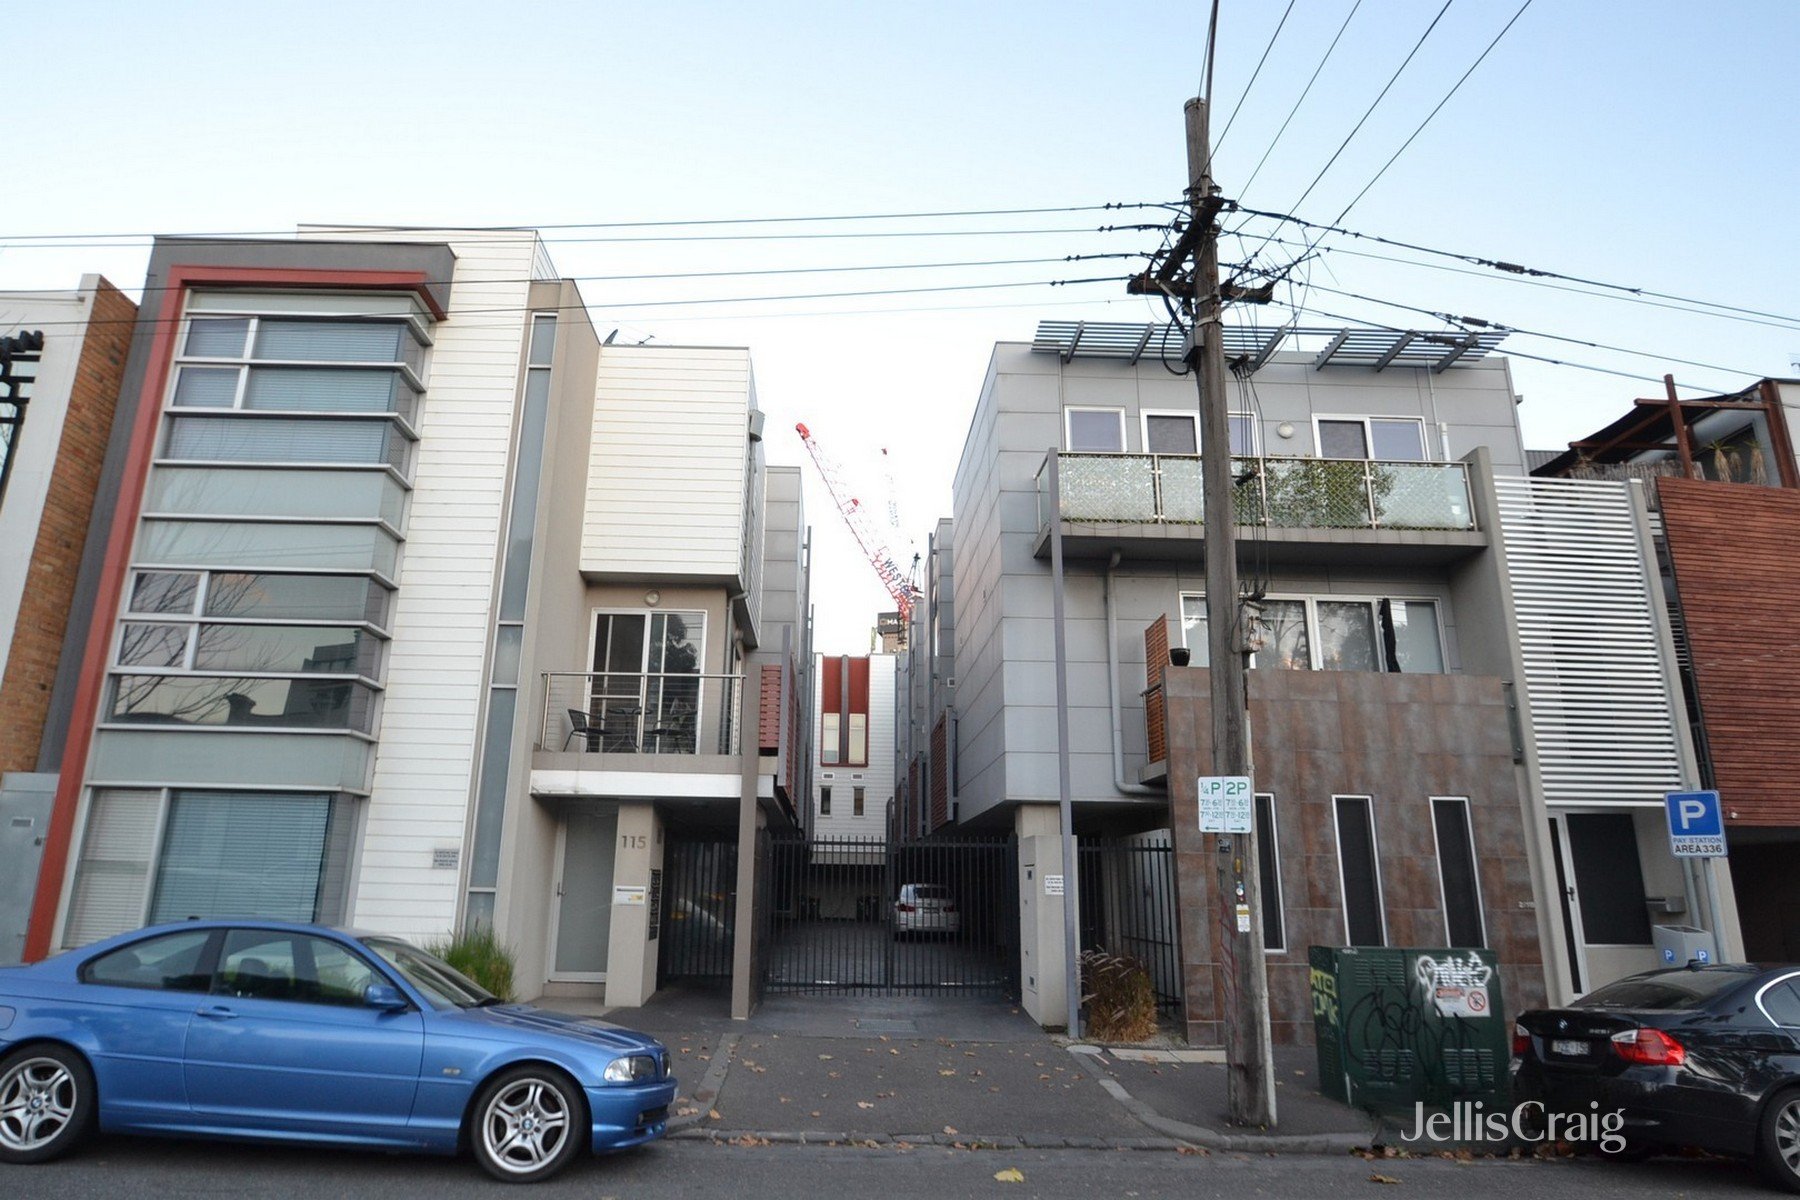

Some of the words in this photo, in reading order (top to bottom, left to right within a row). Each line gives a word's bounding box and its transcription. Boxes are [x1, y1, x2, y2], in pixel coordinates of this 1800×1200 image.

[1226, 781, 1248, 796] 2P
[1678, 800, 1706, 829] P
[621, 835, 646, 849] 115
